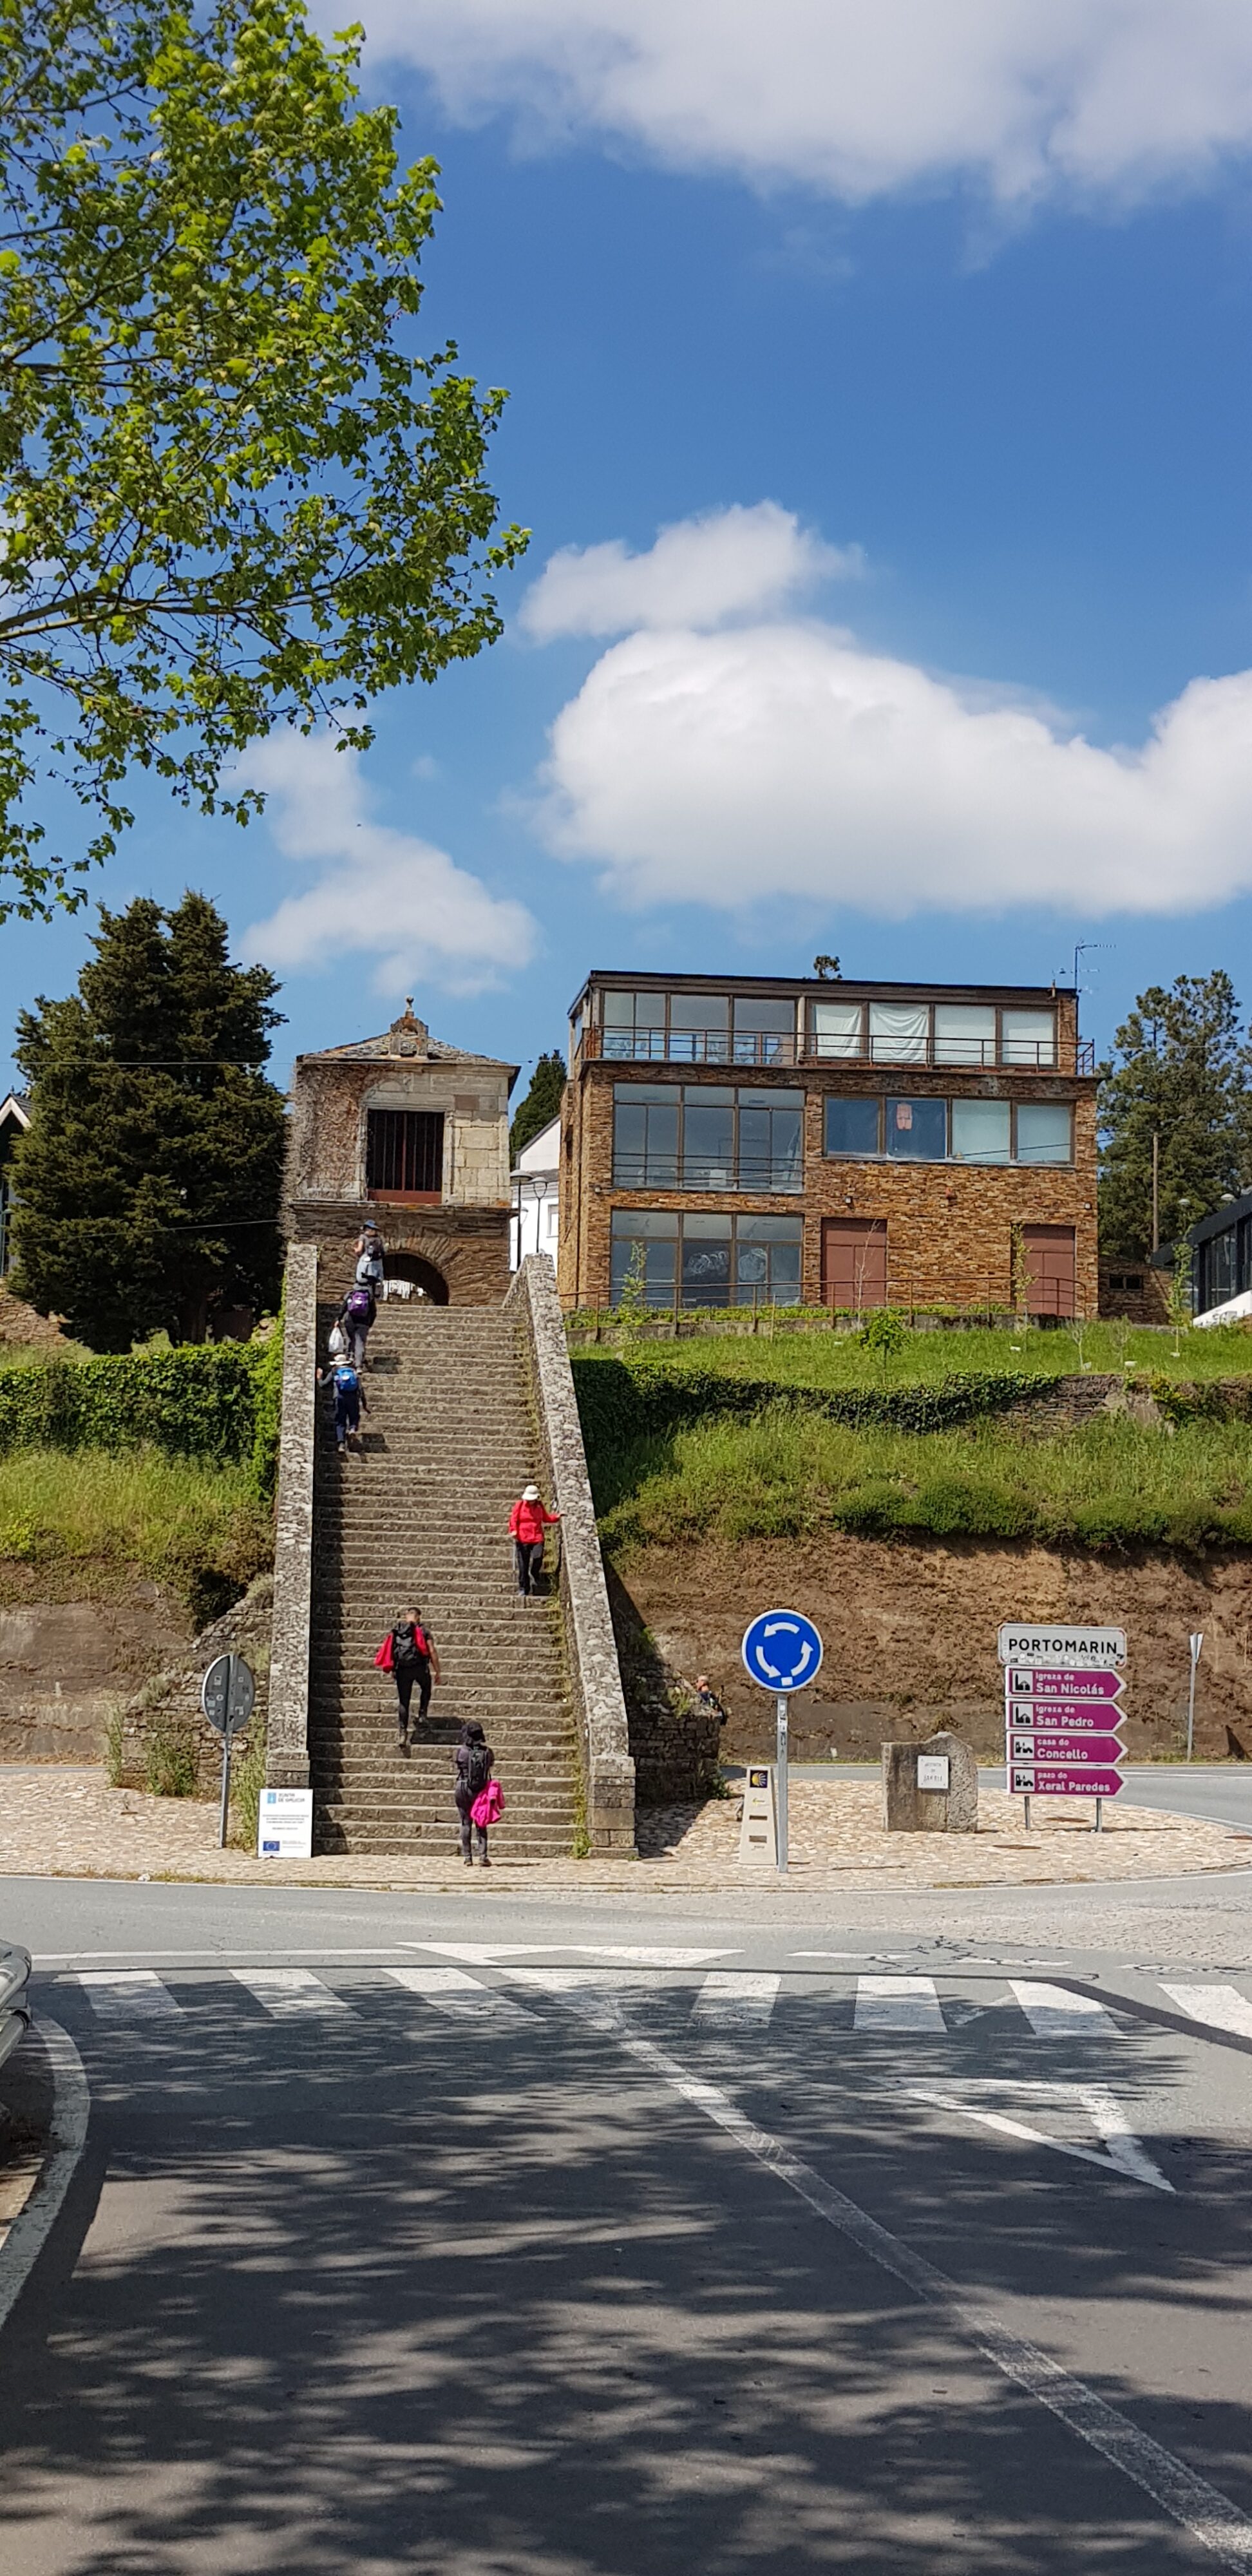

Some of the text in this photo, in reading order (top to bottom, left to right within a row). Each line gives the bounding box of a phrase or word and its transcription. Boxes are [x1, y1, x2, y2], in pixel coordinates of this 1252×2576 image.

[1009, 1638, 1117, 1654] PORTOMARIN
[1064, 1672, 1074, 1681] de
[1036, 1683, 1104, 1694] San Nicolás
[1036, 1716, 1094, 1727] San Pedro
[1037, 1748, 1088, 1759] Concello
[1038, 1781, 1110, 1792] Xeral Paredes
